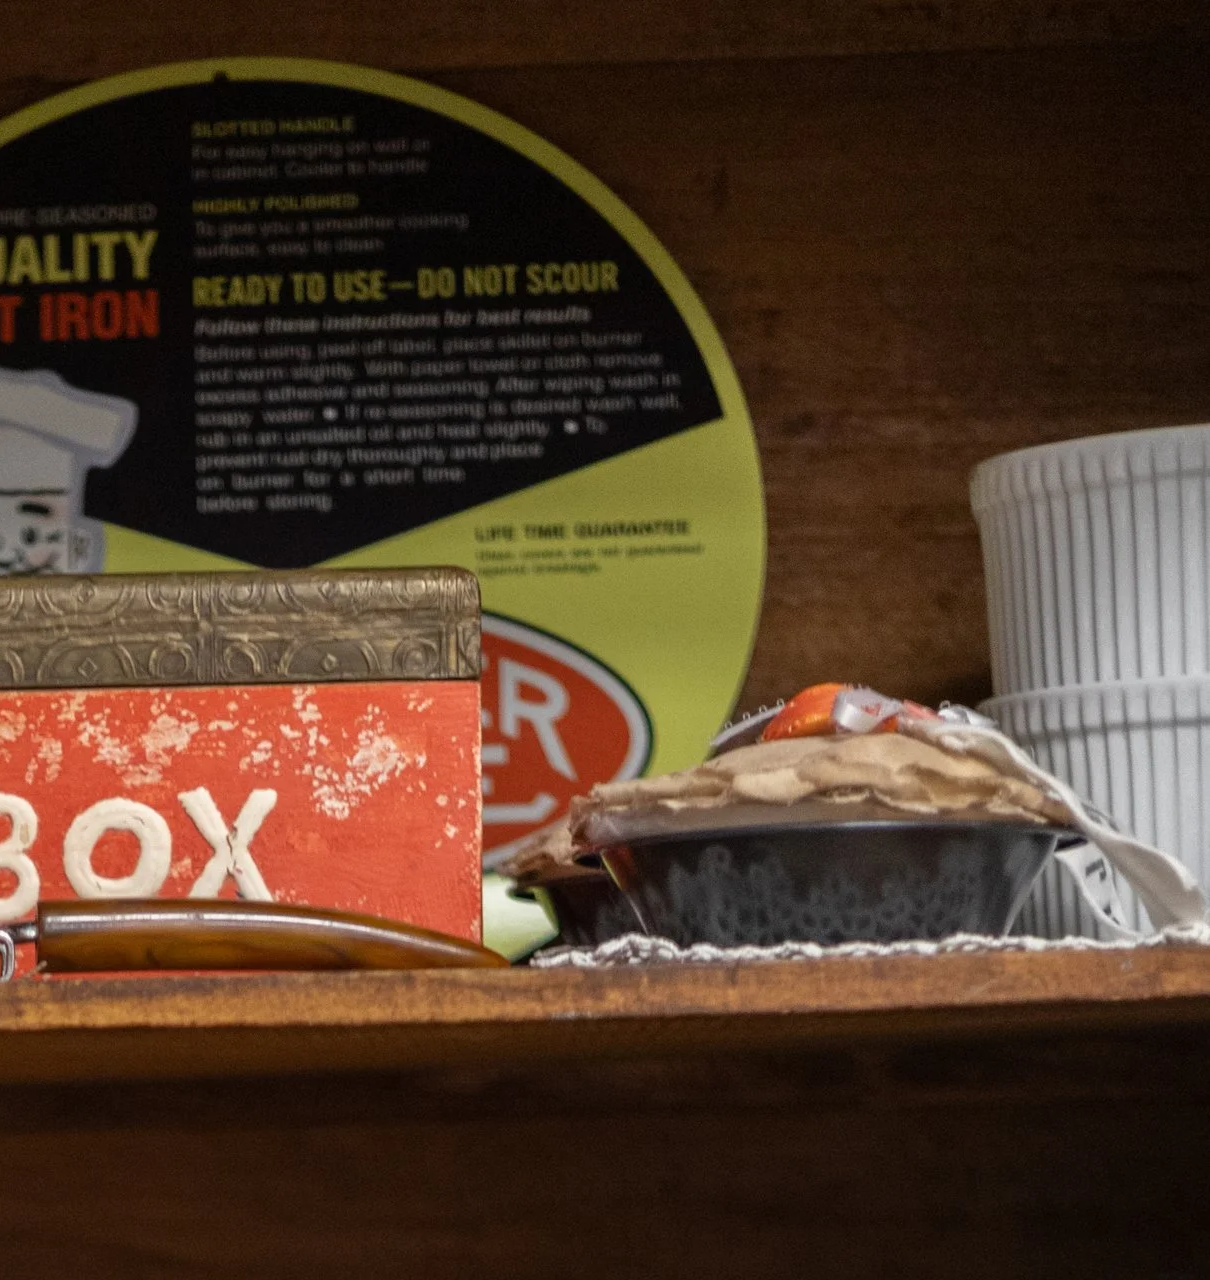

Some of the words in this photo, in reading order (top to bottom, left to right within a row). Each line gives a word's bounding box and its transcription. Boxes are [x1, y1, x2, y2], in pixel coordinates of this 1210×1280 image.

[277, 115, 355, 135] HANDLE
[263, 193, 360, 211] POLISHED
[191, 274, 282, 308] READY
[290, 272, 326, 303] TO
[463, 265, 518, 296] NOT
[527, 261, 619, 294] SCOUR
[38, 289, 160, 342] IRON
[573, 519, 689, 539] GUARANTEE
